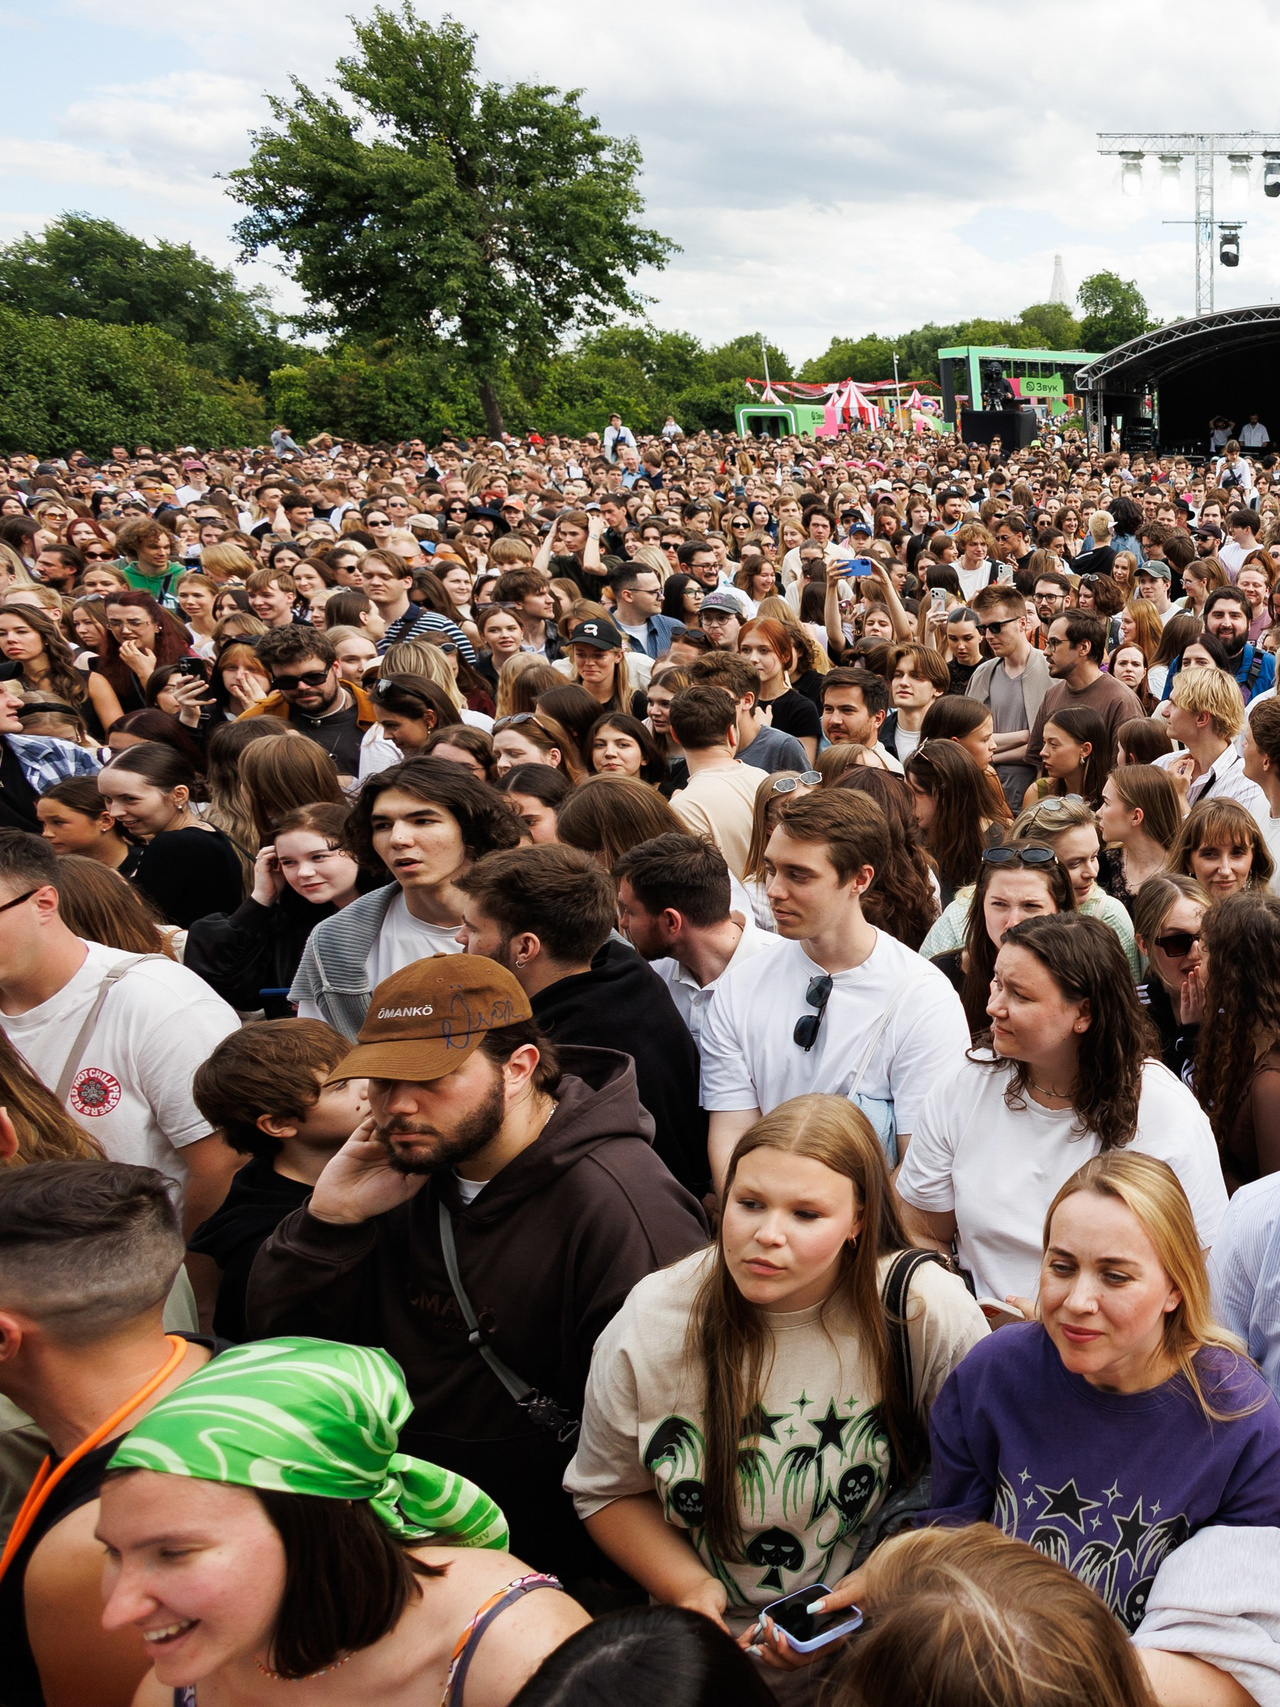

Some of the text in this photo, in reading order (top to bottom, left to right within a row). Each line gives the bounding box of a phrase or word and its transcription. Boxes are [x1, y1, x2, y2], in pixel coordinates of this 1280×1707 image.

[1036, 382, 1058, 393] Звук
[71, 1069, 120, 1115] RED HOT CHILI PEPPERS
